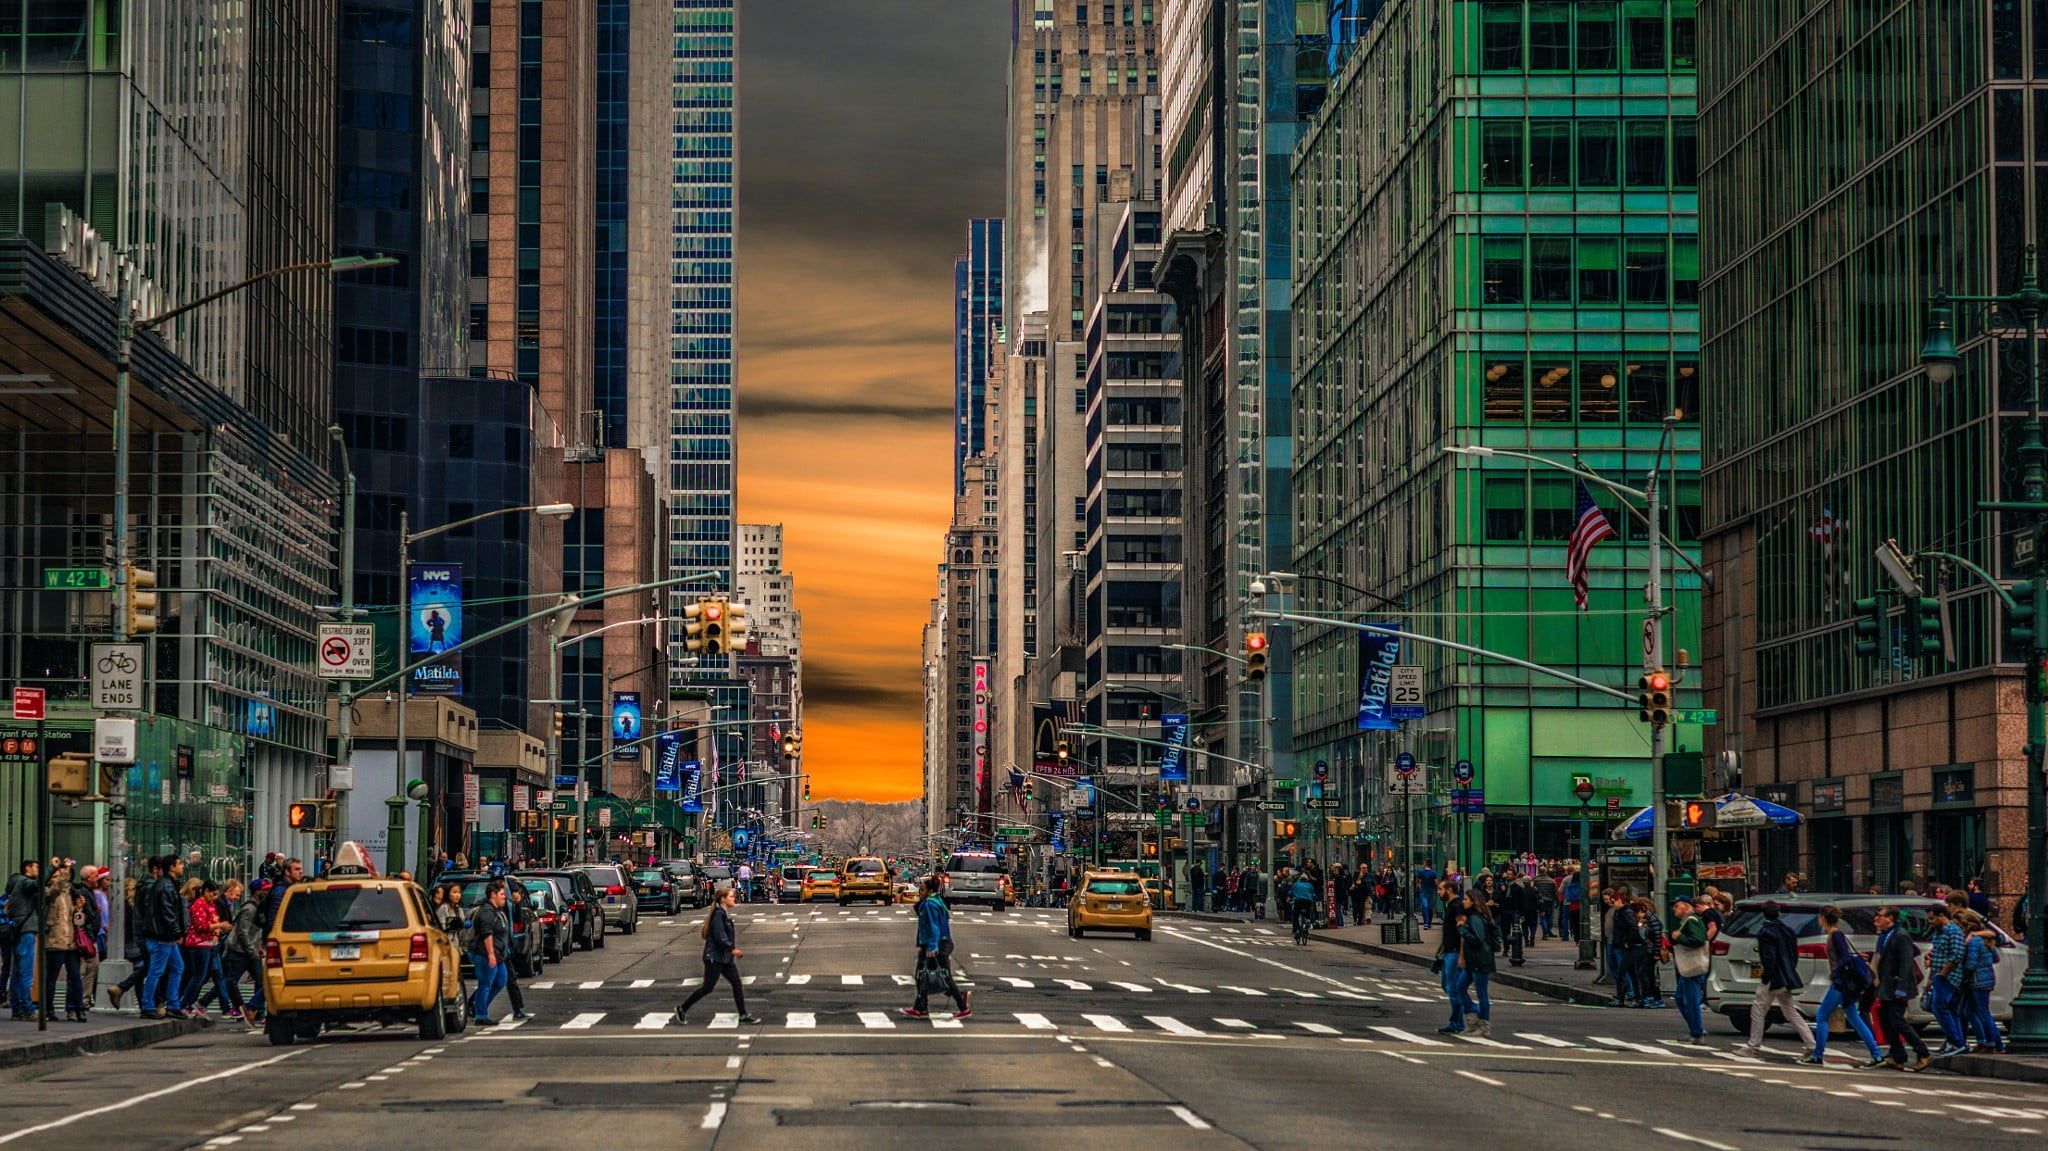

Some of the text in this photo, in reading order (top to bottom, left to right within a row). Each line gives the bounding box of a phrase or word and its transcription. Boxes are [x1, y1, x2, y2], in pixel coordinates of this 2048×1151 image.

[47, 571, 97, 586] W 42 ST
[423, 571, 450, 580] NYC
[322, 626, 370, 635] RESTRICTED AREA
[353, 637, 370, 646] 33FT
[358, 648, 364, 656] &
[352, 658, 370, 666] OVER
[414, 665, 460, 680] Matilda
[101, 679, 133, 690] LANE
[1360, 641, 1400, 720] Matilda
[101, 693, 133, 704] ENDS
[975, 665, 987, 733] RADIO
[1395, 687, 1420, 702] 25
[1678, 712, 1686, 721] W
[1690, 711, 1704, 723] 42
[43, 731, 72, 739] Station
[1162, 724, 1187, 774] Matilda
[657, 742, 680, 784] Matilda
[1035, 765, 1053, 774] OPEN
[1397, 773, 1418, 781] OLY
[1596, 777, 1626, 786] Bank
[683, 770, 701, 807] Matilda
